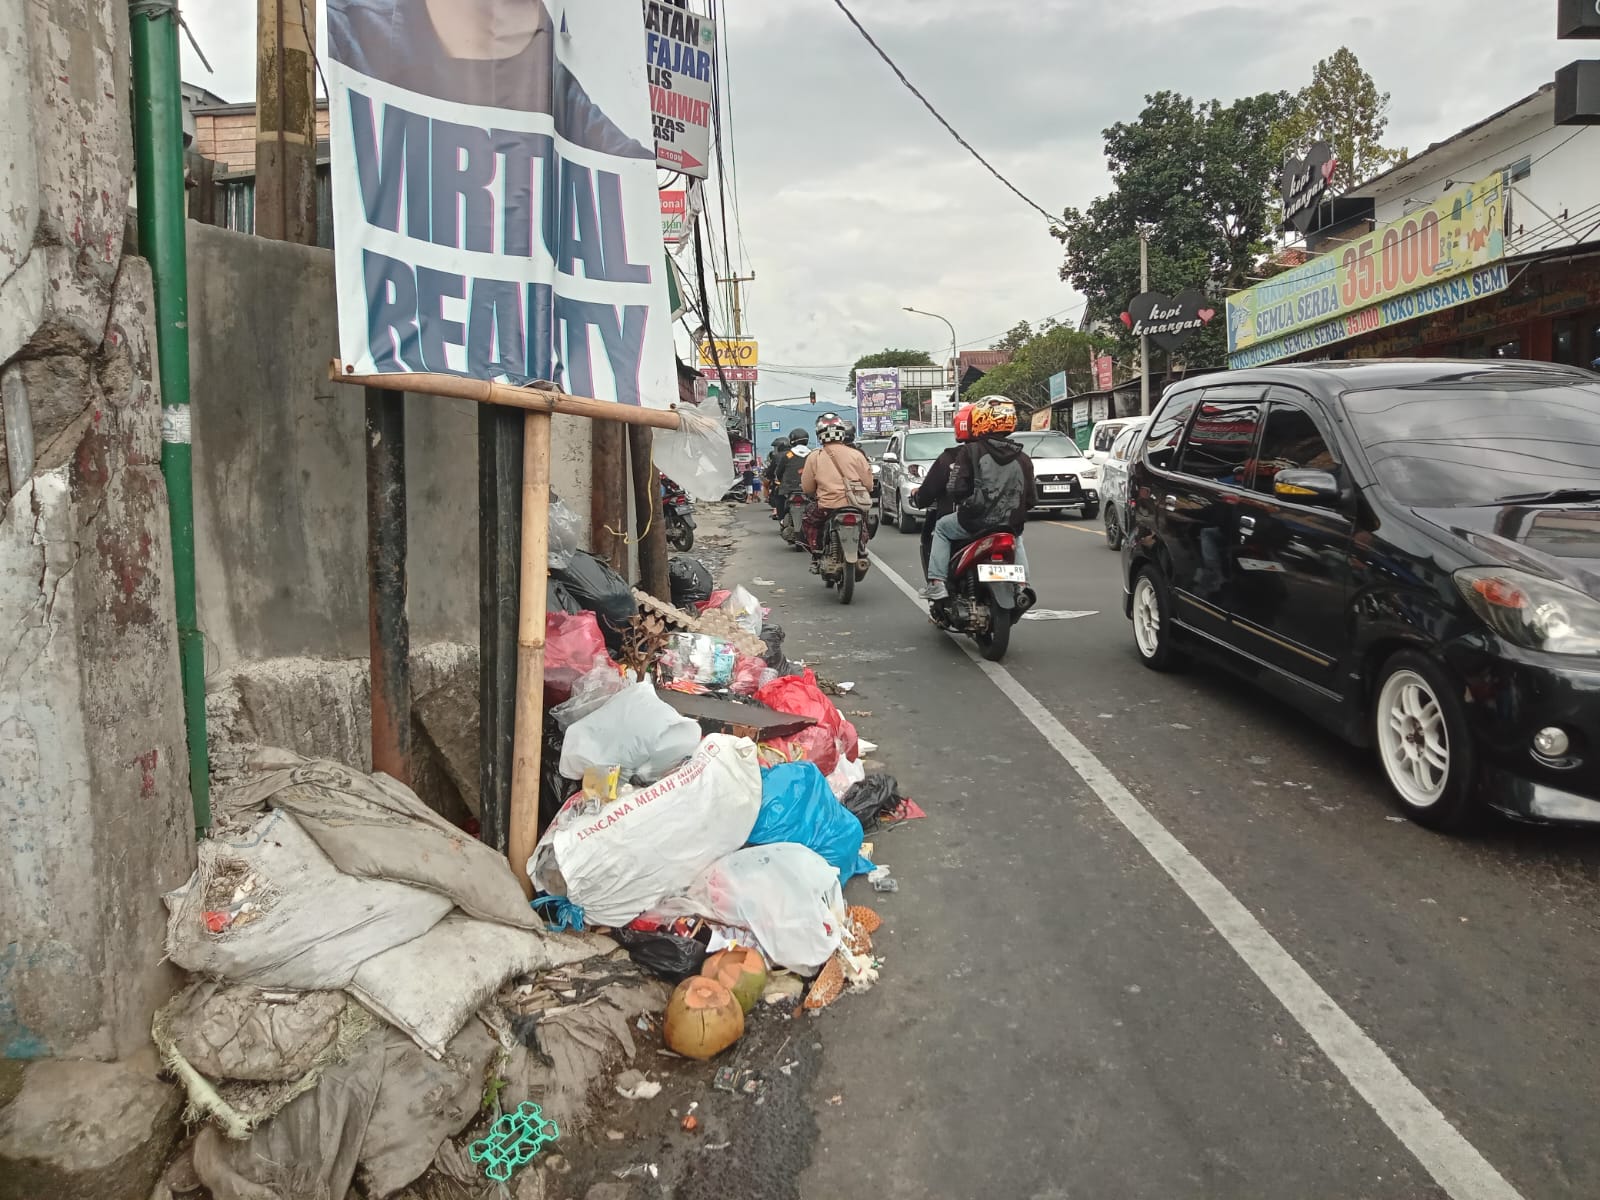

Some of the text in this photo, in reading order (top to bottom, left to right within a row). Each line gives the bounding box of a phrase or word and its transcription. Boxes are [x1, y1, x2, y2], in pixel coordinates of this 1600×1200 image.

[643, 0, 699, 47] ATAN
[647, 32, 711, 82] FAJAR
[347, 88, 652, 284] VIRTUAL
[662, 198, 684, 208] onal
[1256, 211, 1439, 337] SEMUA SERBA 35.000
[1256, 255, 1336, 307] TOKO BUSANA
[362, 248, 649, 406] REALTY
[1131, 319, 1202, 335] kenangan
[1149, 304, 1182, 320] kopi
[1230, 353, 1249, 369] TOKO
[1251, 341, 1283, 364] BUSANA
[1284, 331, 1314, 355] SEMUA
[1314, 320, 1346, 345] SERBA
[1346, 308, 1379, 335] 35.000
[1382, 298, 1414, 324] TOKO
[1416, 278, 1470, 313] BUSANA
[577, 780, 676, 841] LENCANA MERAH
